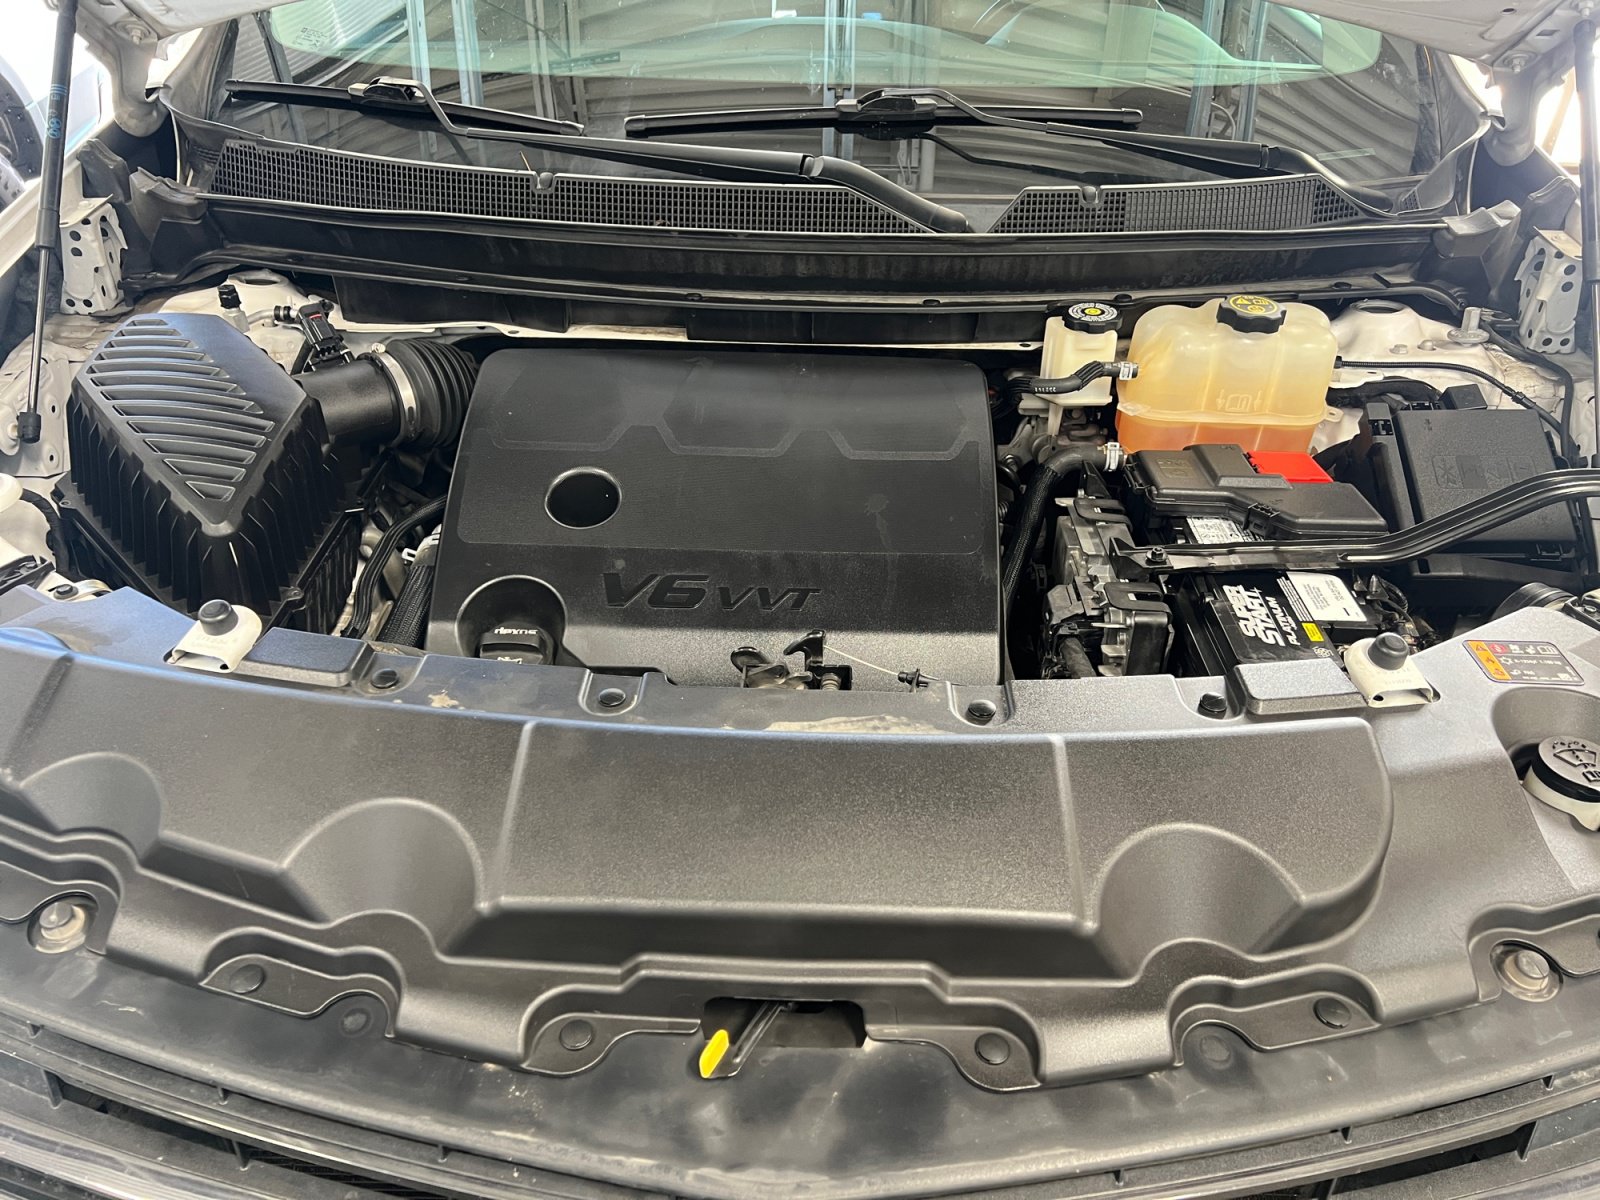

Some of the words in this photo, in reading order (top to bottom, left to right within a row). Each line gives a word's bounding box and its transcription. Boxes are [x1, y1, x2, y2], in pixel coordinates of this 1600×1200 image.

[601, 572, 710, 609] V6
[717, 586, 822, 611] VVT
[1222, 584, 1257, 637] SUPER
[1236, 584, 1285, 647] START
[1265, 596, 1301, 646] PLATINUM
